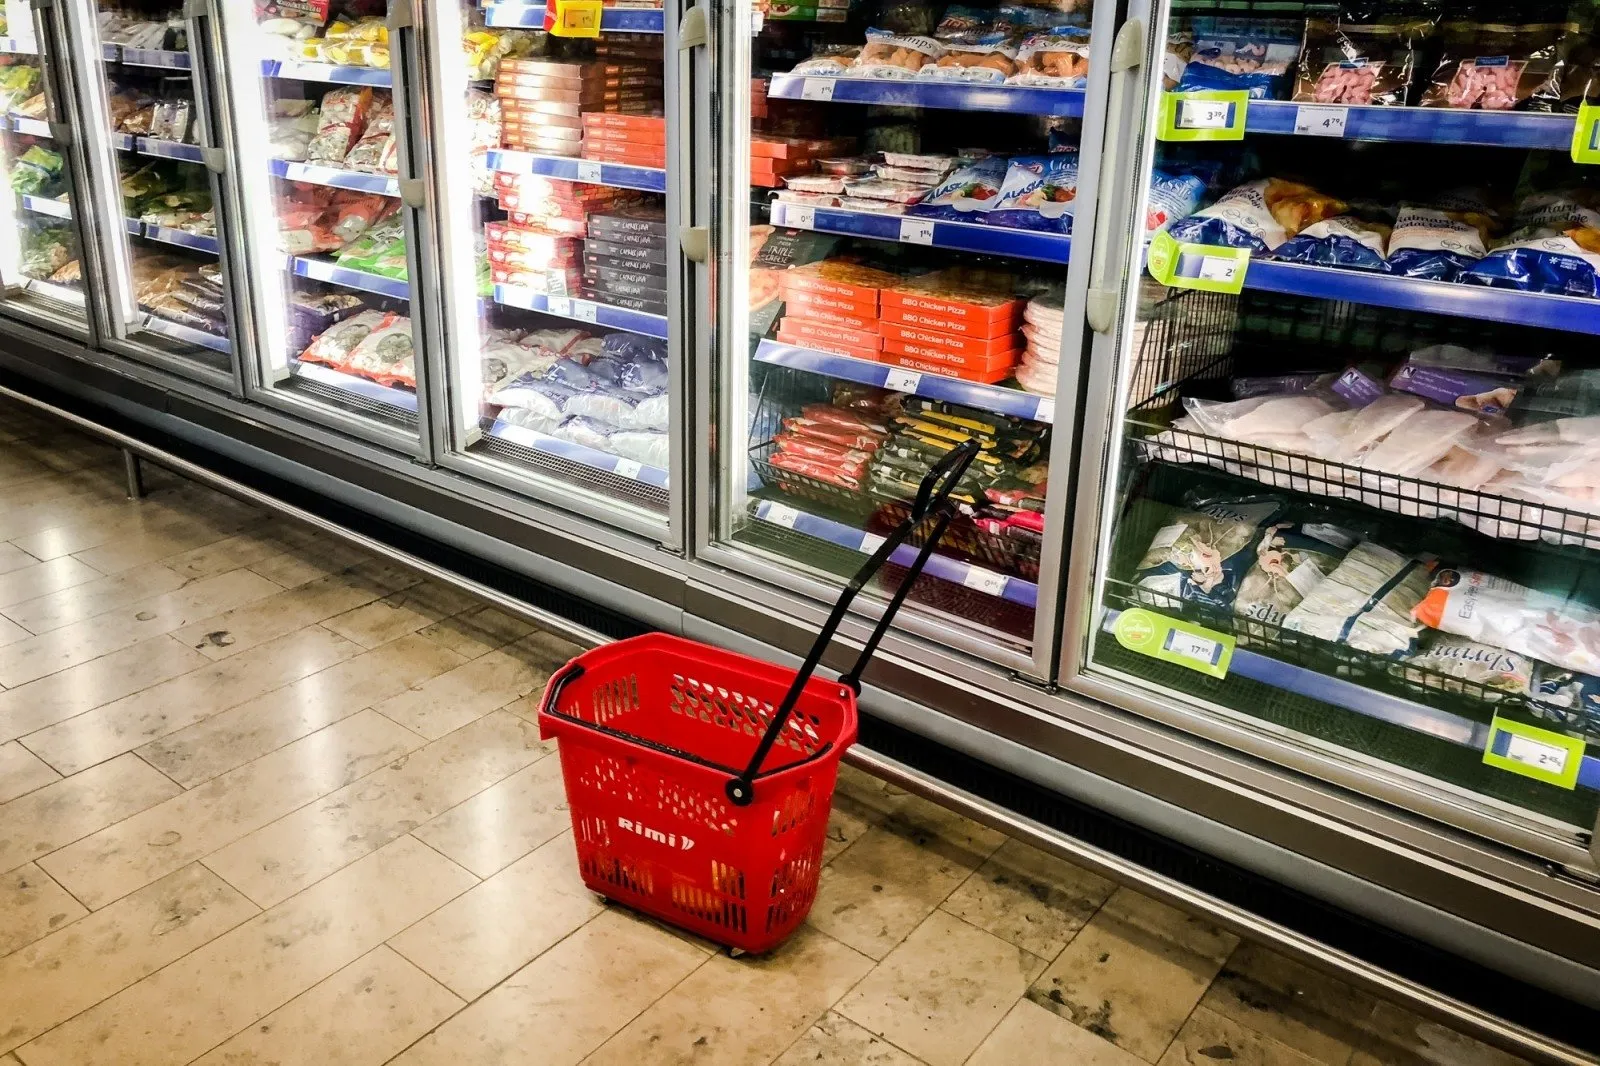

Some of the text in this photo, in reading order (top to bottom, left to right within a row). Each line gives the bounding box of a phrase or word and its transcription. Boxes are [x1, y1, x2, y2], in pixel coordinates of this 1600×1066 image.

[1002, 179, 1045, 200] ALASKA
[768, 245, 796, 258] TRIPLE
[813, 283, 837, 293] Chicken
[837, 287, 854, 296] Pizza
[813, 296, 837, 306] Chicken
[837, 301, 855, 310] Pizza
[902, 298, 966, 315] BBQ Chicken Pizza
[820, 311, 845, 322] Chicken
[845, 316, 862, 326] Pizza
[902, 313, 966, 331] BBQ Chicken Pizza
[817, 328, 842, 339] Chicken
[842, 333, 860, 343] Pizza
[900, 330, 964, 348] BBQ Chicken Pizza
[904, 345, 965, 364] BBQ Chicken Pizza
[900, 357, 959, 377] BBQ Chicken Pizza
[1425, 645, 1516, 672] Shrim
[618, 816, 676, 848] Rimi
